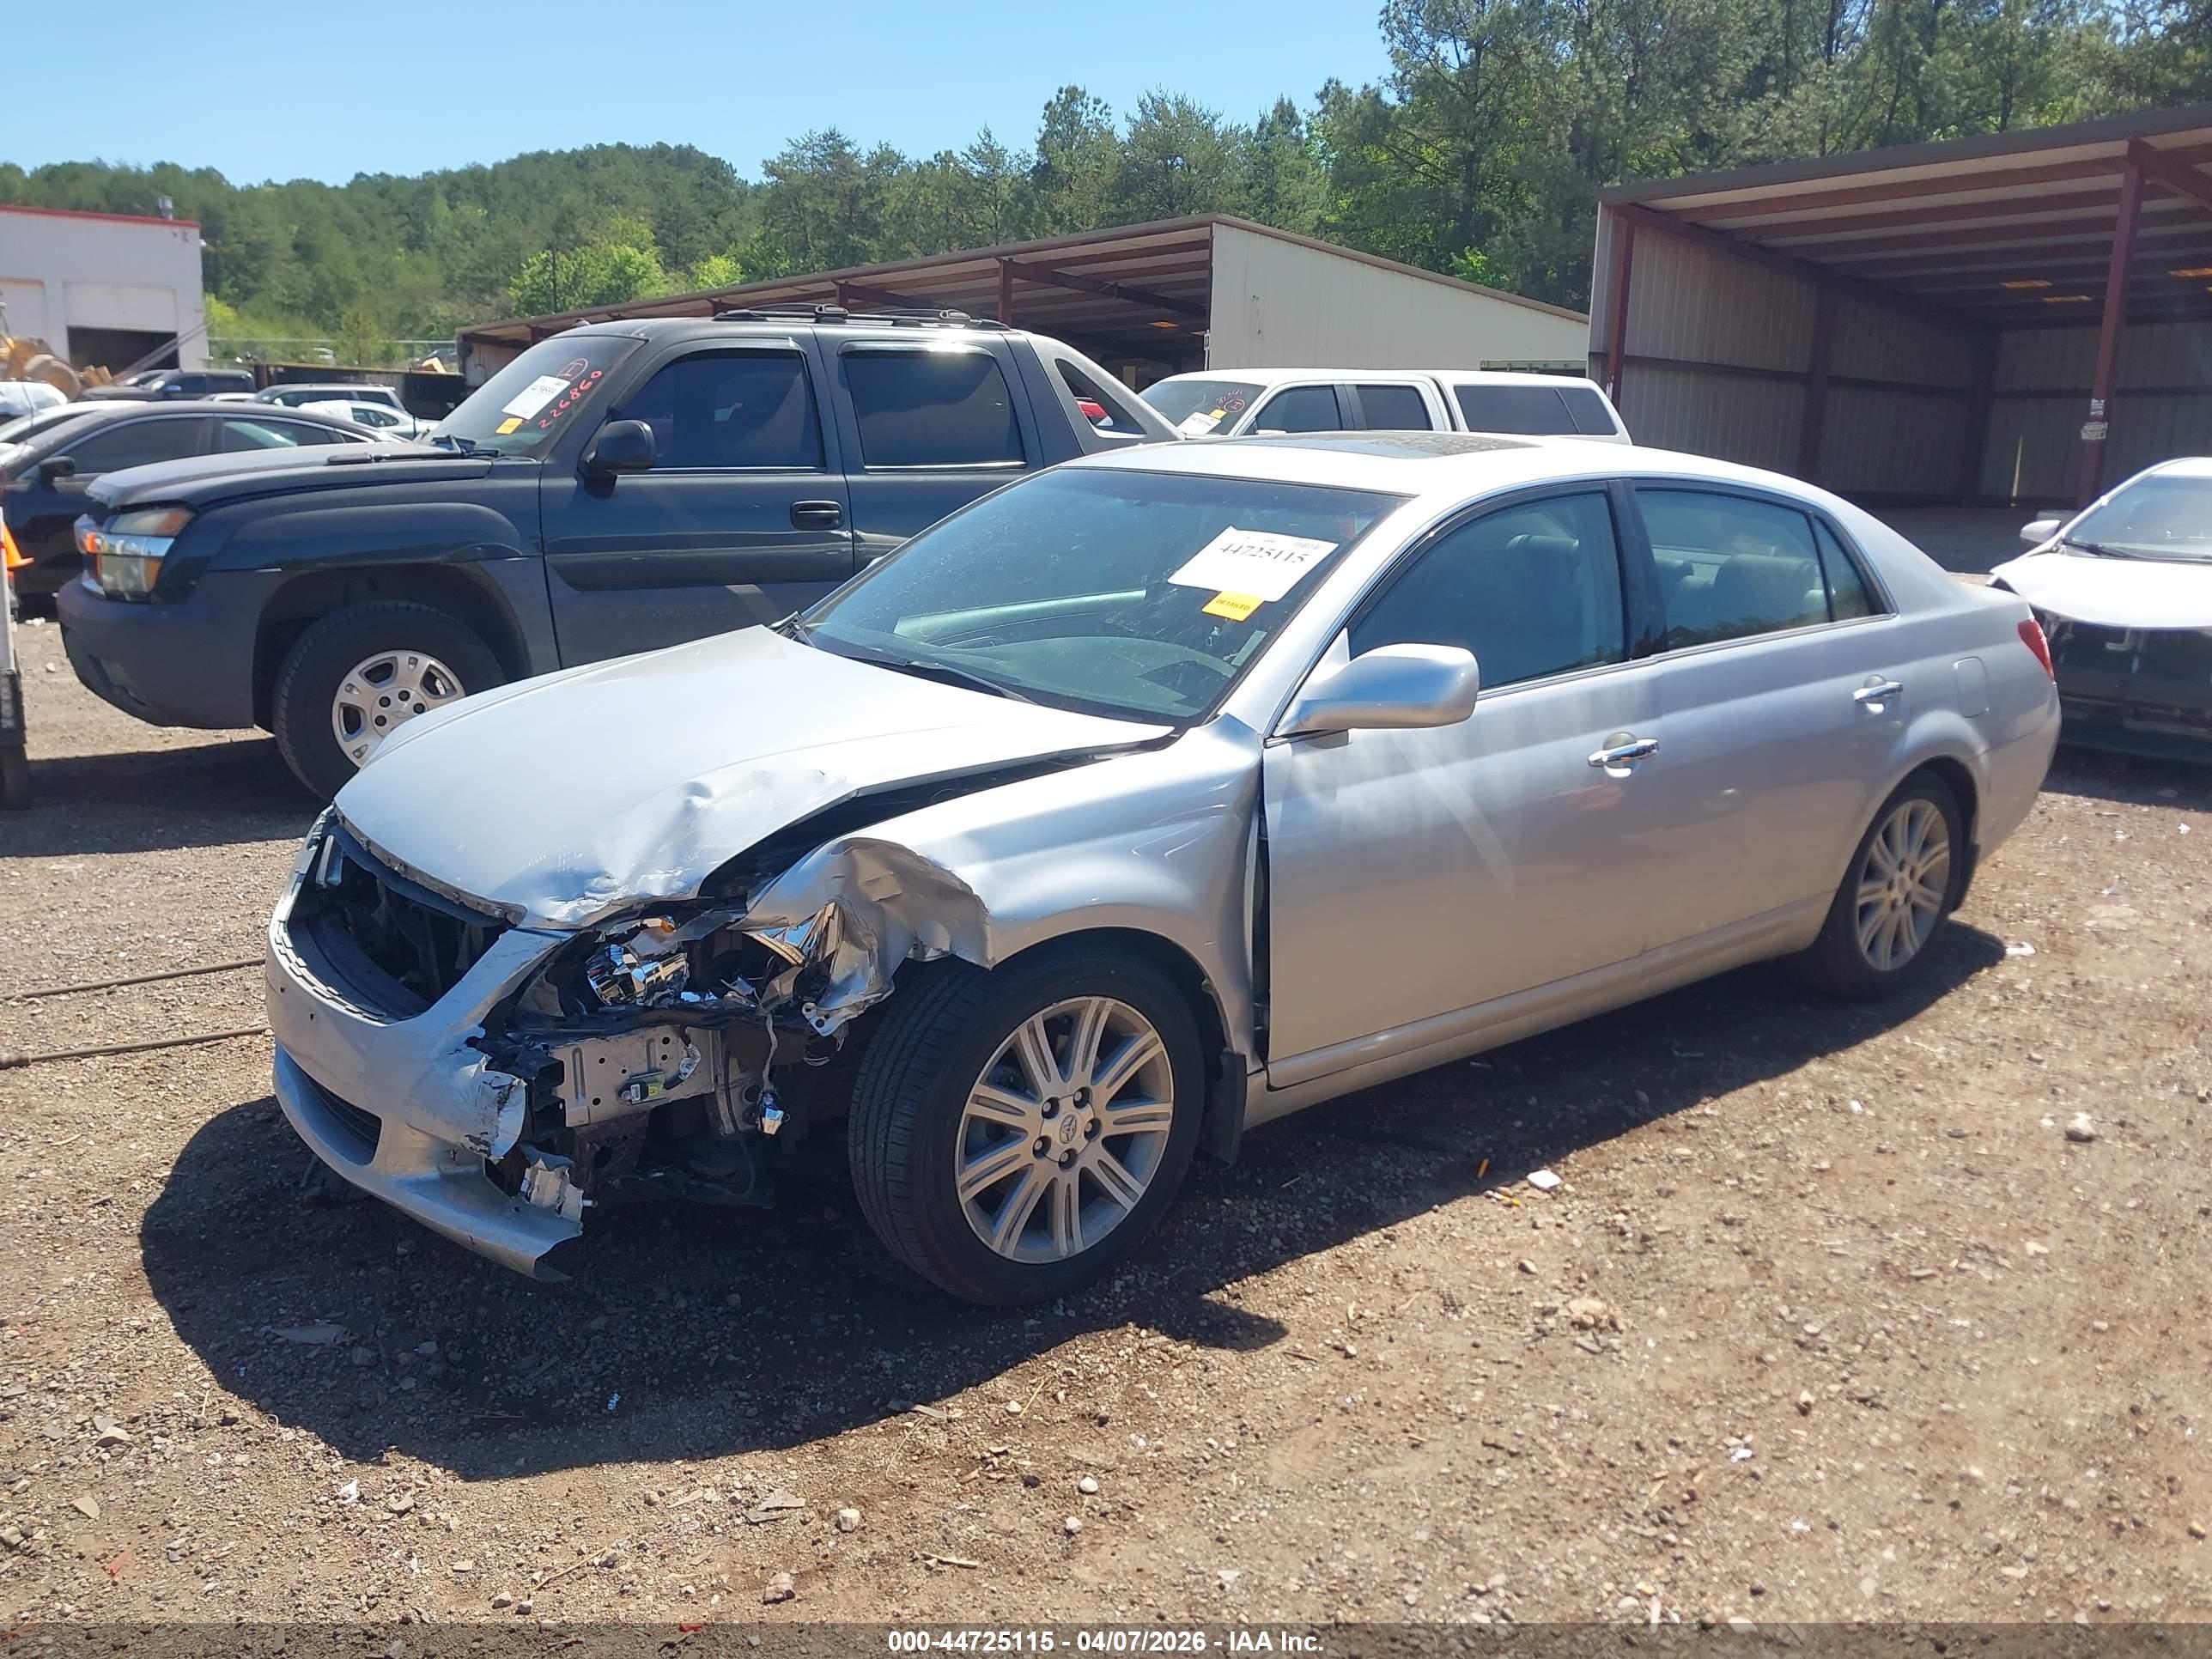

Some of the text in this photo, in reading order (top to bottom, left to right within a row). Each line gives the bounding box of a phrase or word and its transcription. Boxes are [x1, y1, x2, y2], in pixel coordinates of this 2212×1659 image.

[538, 370, 603, 428] 226860
[1219, 543, 1310, 564] 44725115
[1215, 599, 1250, 611] DETAILED
